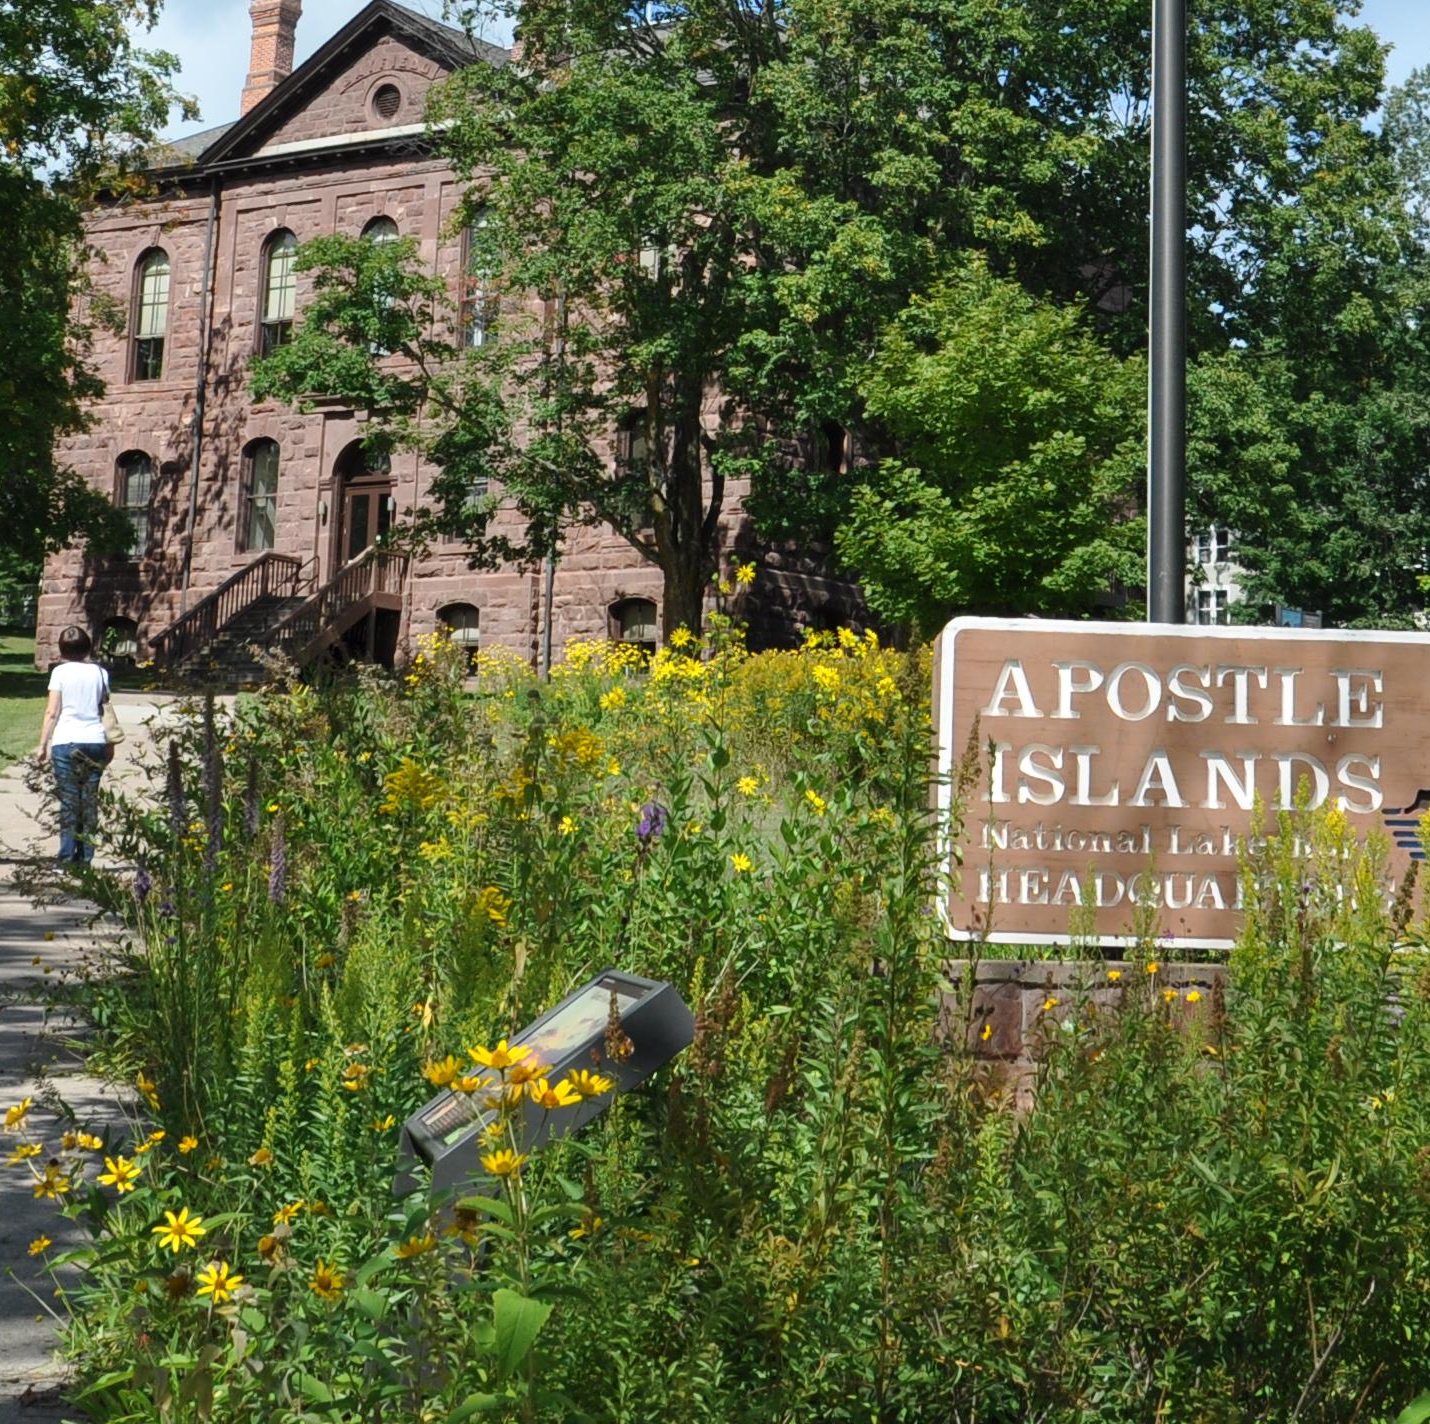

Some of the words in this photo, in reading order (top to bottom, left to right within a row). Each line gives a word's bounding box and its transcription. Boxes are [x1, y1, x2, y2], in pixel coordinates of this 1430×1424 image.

[980, 657, 1384, 728] APOSTLE
[981, 741, 1384, 814] ISLANDS
[978, 818, 1152, 854] National
[1167, 823, 1374, 860] Lakeh
[975, 864, 1397, 915] HEADQUA
